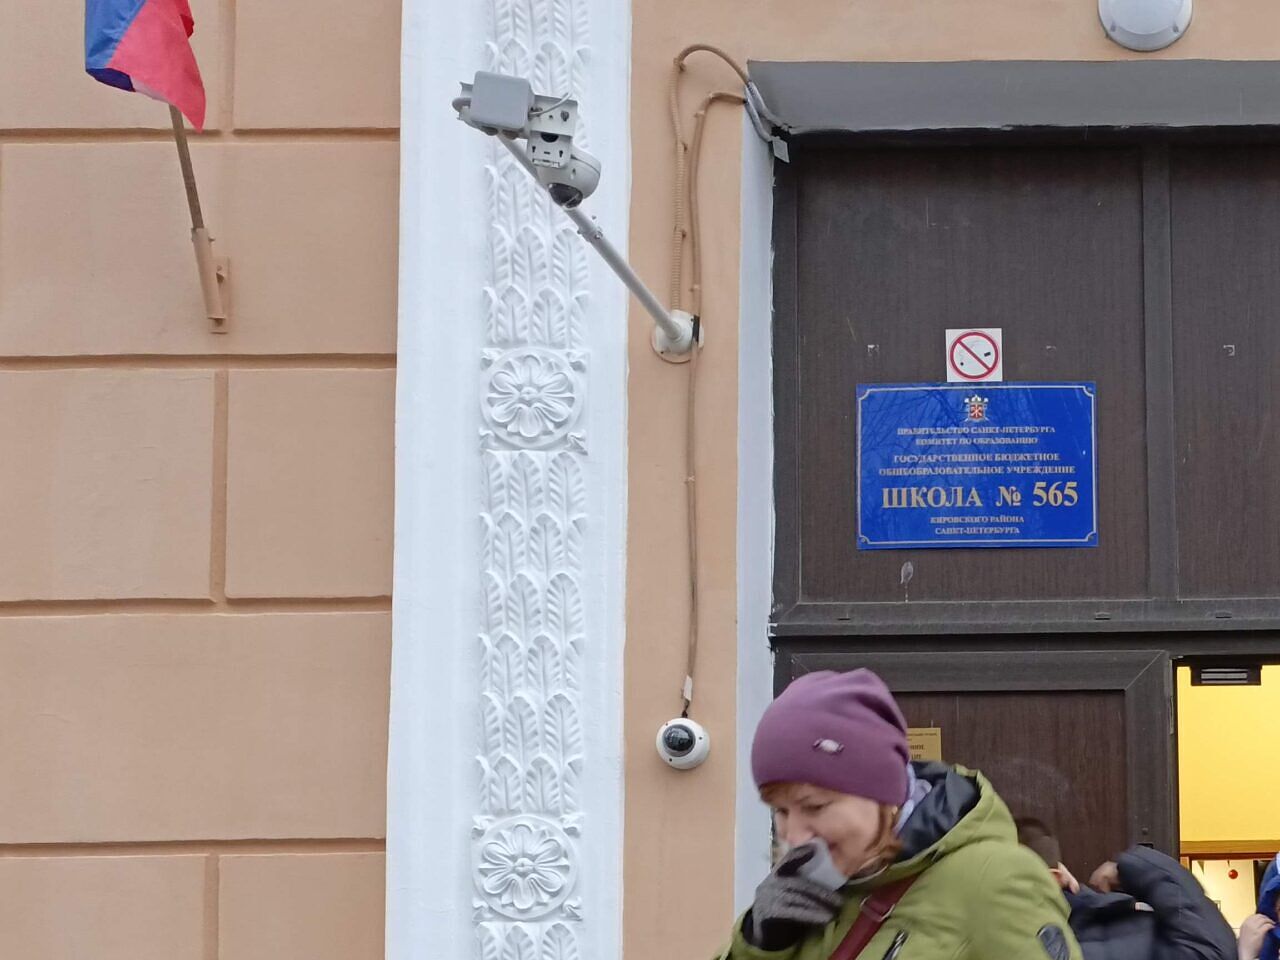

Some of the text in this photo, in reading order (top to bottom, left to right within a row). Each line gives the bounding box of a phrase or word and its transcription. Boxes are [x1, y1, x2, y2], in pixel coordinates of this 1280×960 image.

[971, 426, 1056, 434] САНКТ-ПЕТЕРБУРГА
[974, 437, 1038, 445] ОБРАЗОВАНИЮ
[894, 453, 1060, 463] ГОСУДАРСТВЕННОЕ БЮДЖЕТНОЕ
[1007, 466, 1076, 475] УЧРЕЖДЕНИЕ
[881, 481, 1079, 508] ШКОЛА № 565
[990, 514, 1025, 523] РАЙОНА
[935, 526, 1020, 535] САНКТ-ПЕТЕРБУРГА
